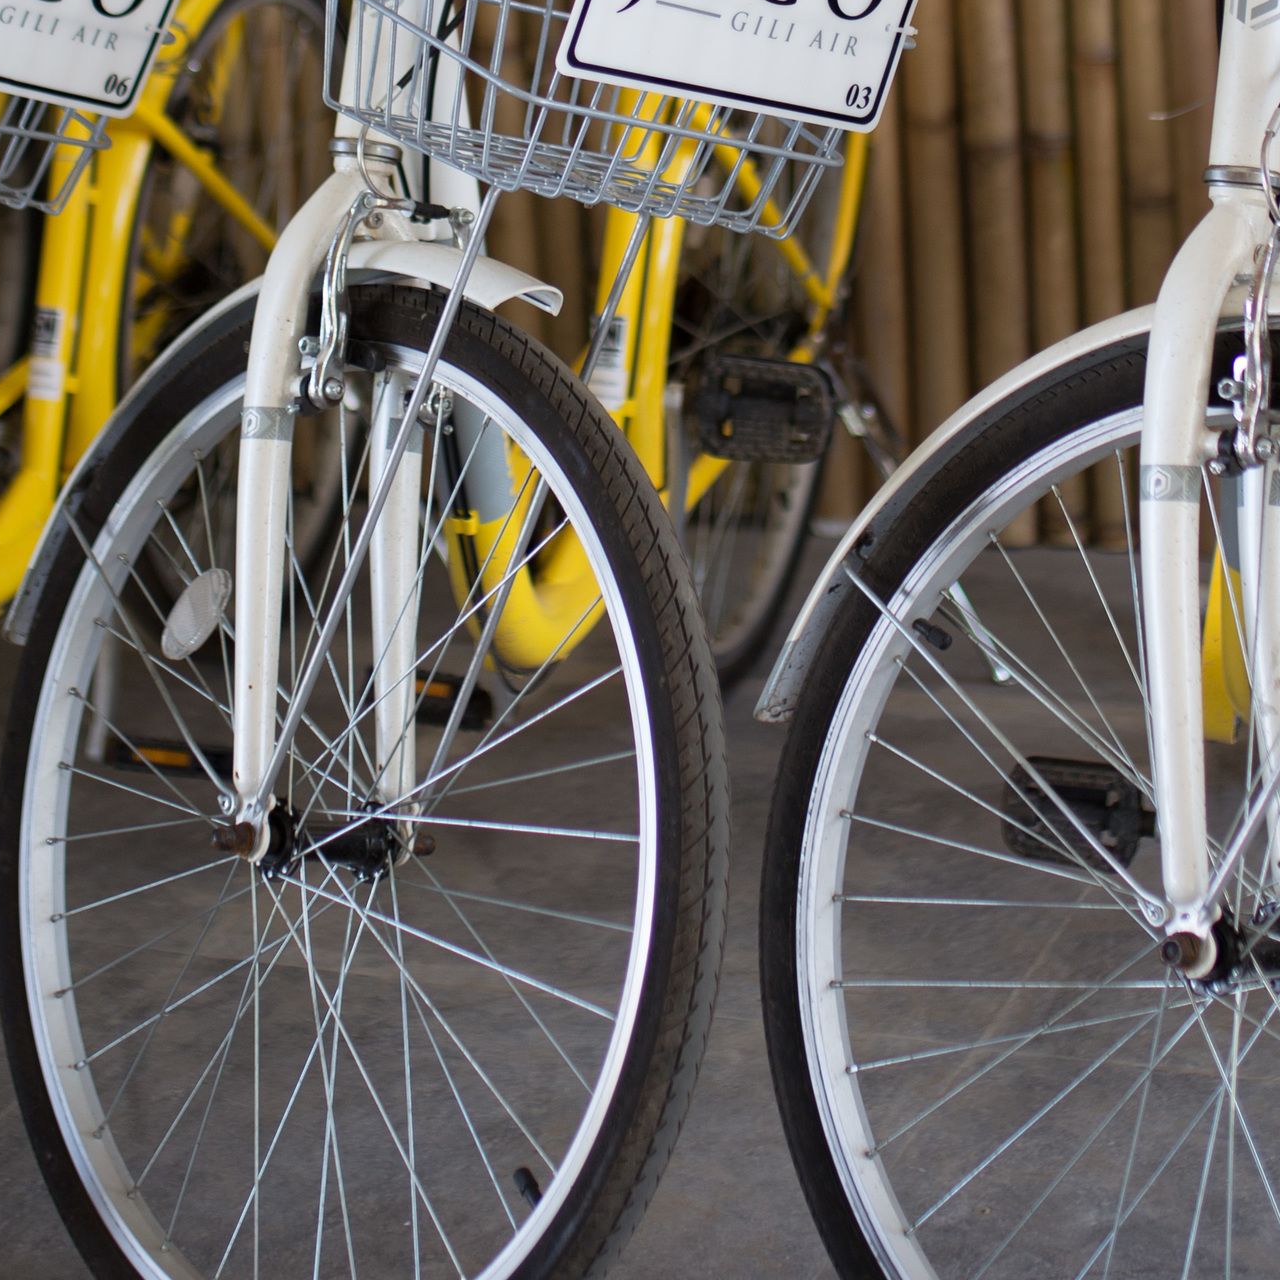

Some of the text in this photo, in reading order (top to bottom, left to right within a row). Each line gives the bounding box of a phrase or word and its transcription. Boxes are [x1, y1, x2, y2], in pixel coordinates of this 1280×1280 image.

[71, 24, 119, 51] AIR
[730, 10, 858, 57] GILI AIR
[104, 73, 130, 98] 06
[845, 82, 872, 110] 03
